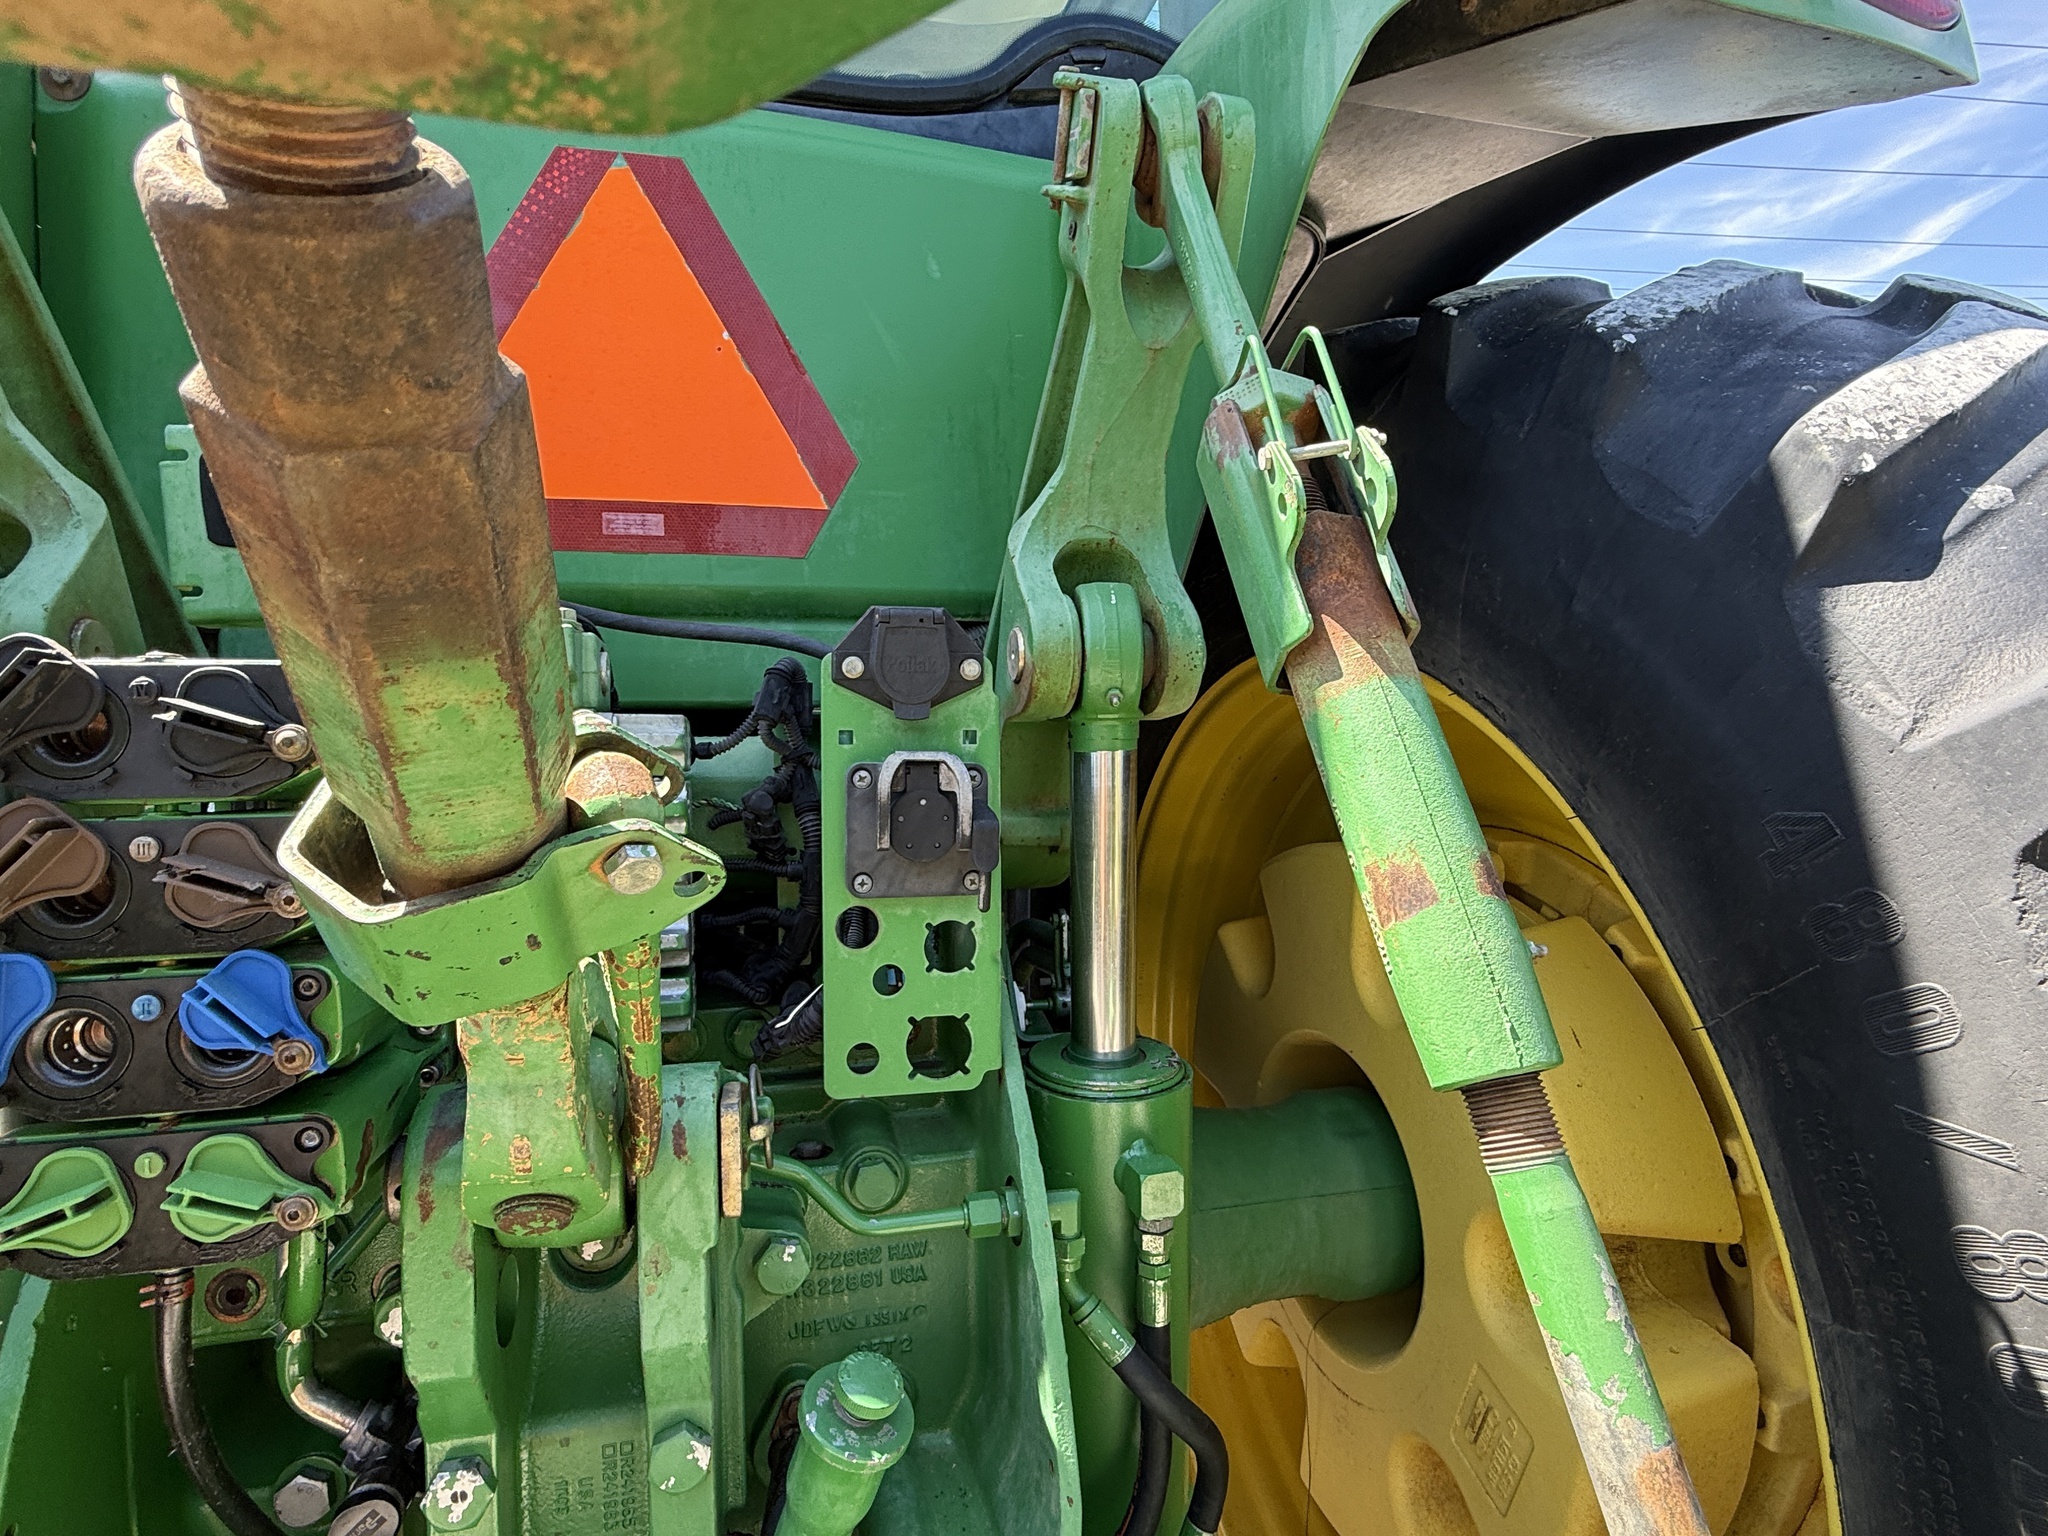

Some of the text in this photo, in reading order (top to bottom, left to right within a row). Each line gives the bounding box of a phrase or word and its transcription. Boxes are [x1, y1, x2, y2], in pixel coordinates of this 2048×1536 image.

[1849, 1151, 1897, 1261] TRACTOR
[887, 1239, 929, 1261] RAW
[786, 1268, 883, 1299] 322881
[890, 1263, 928, 1285] USA
